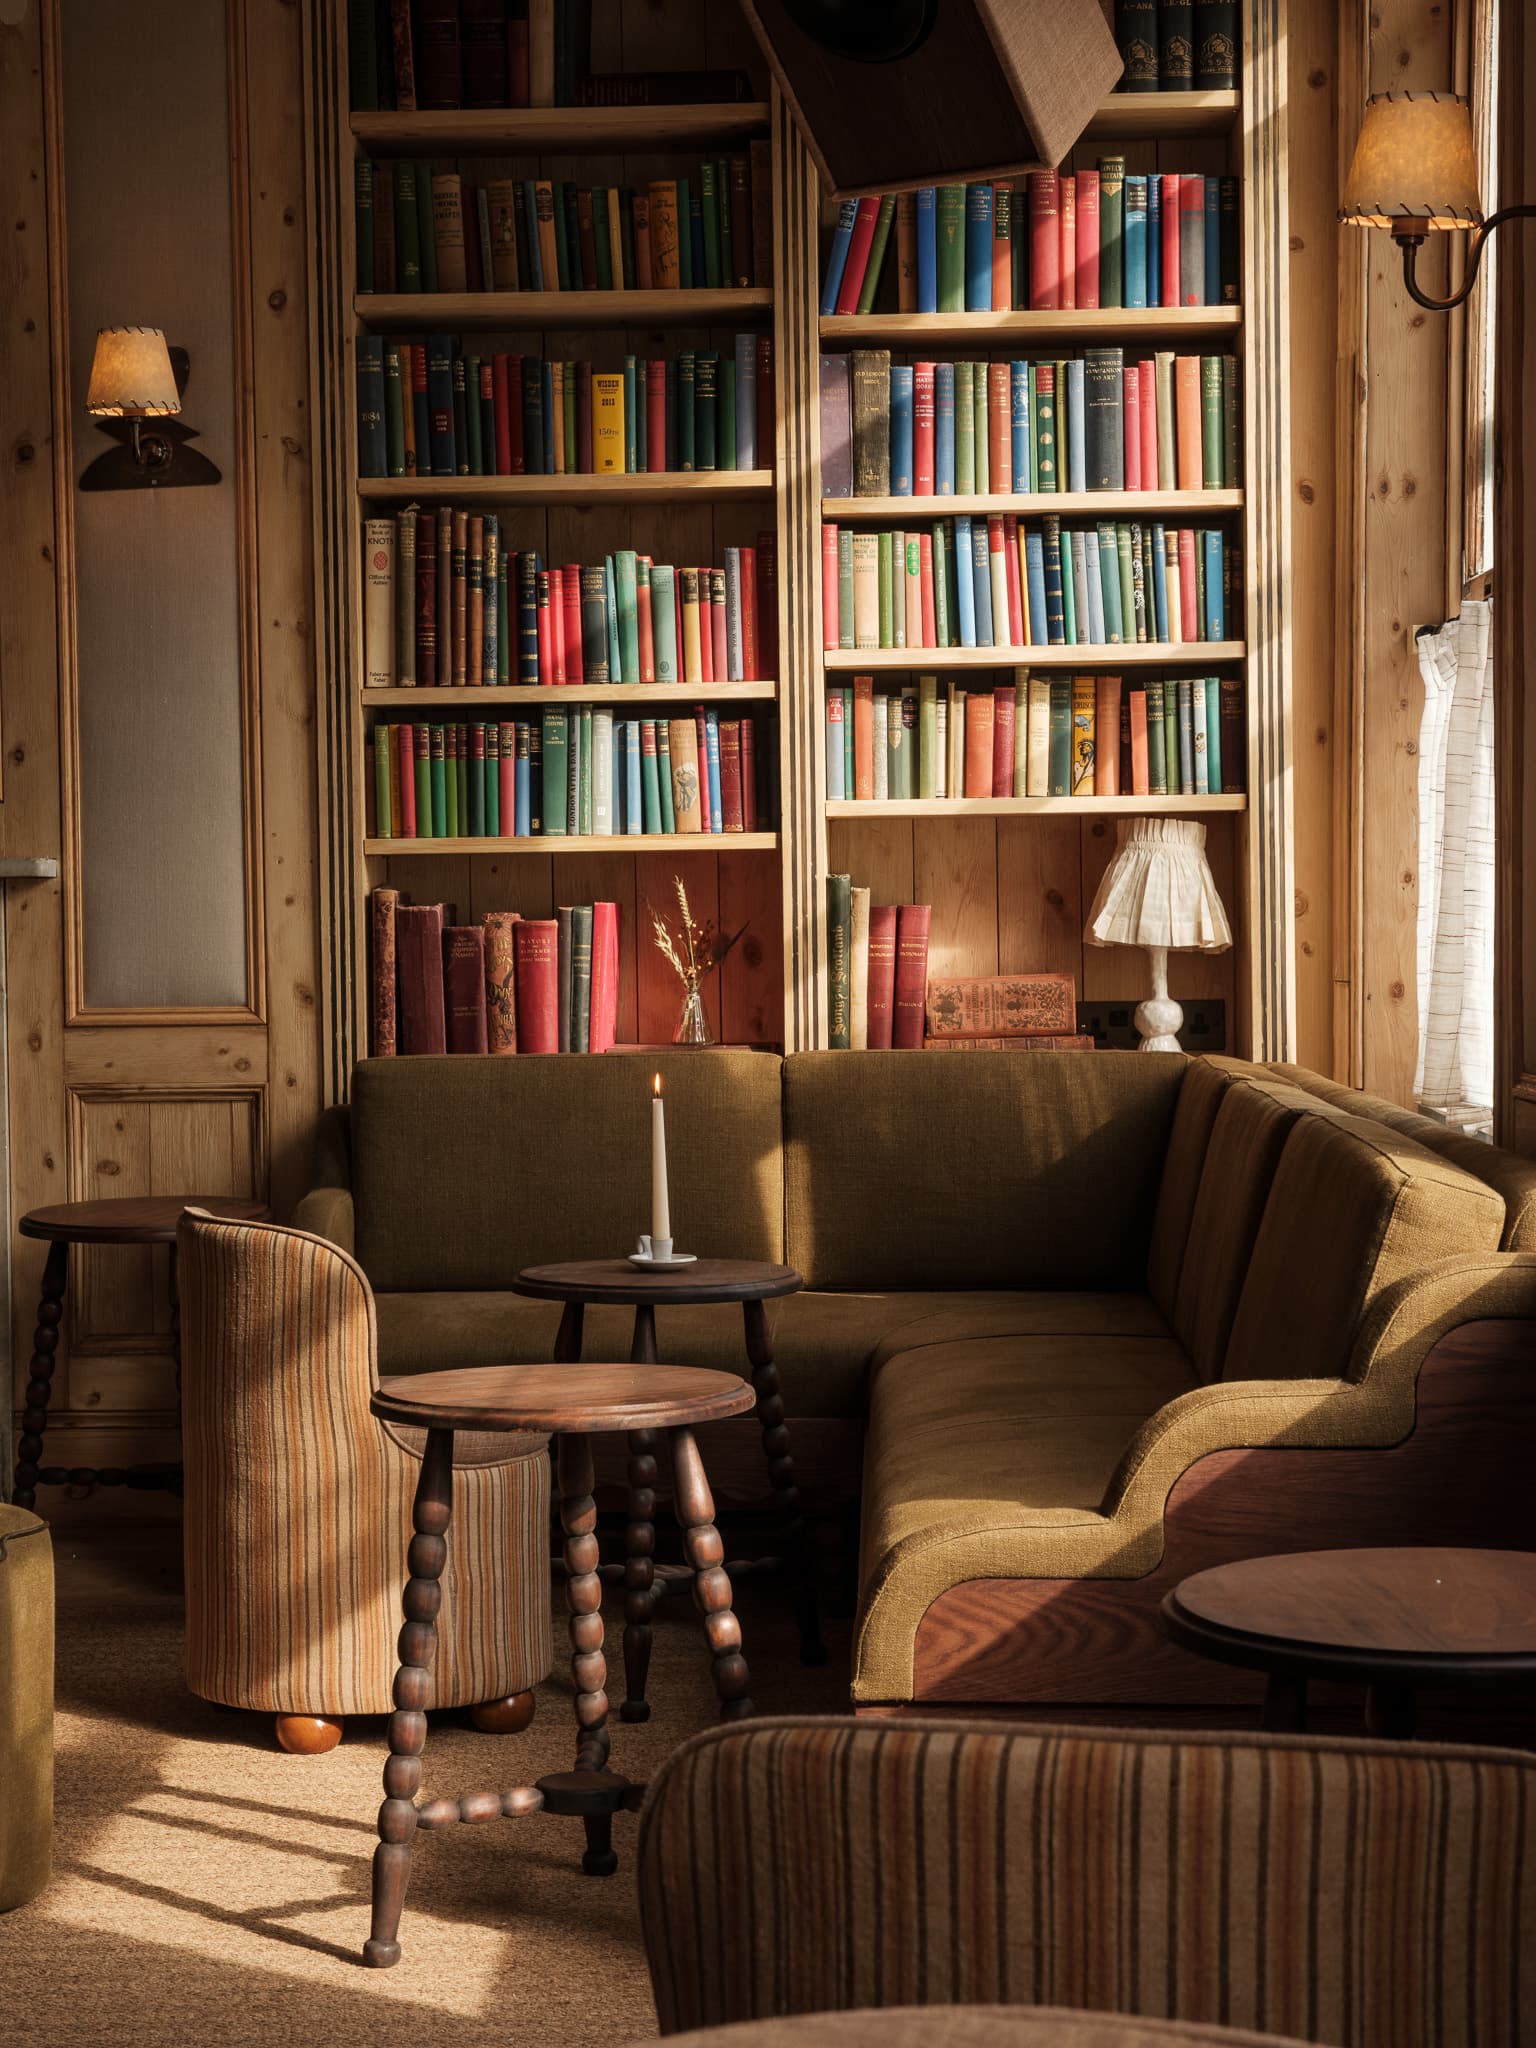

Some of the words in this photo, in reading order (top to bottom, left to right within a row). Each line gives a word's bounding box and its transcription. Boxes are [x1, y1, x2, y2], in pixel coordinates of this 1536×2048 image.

[367, 537, 394, 545] KNOTS
[569, 793, 577, 827] LONDON
[832, 925, 847, 984] Scotland
[832, 993, 847, 1037] Songs
